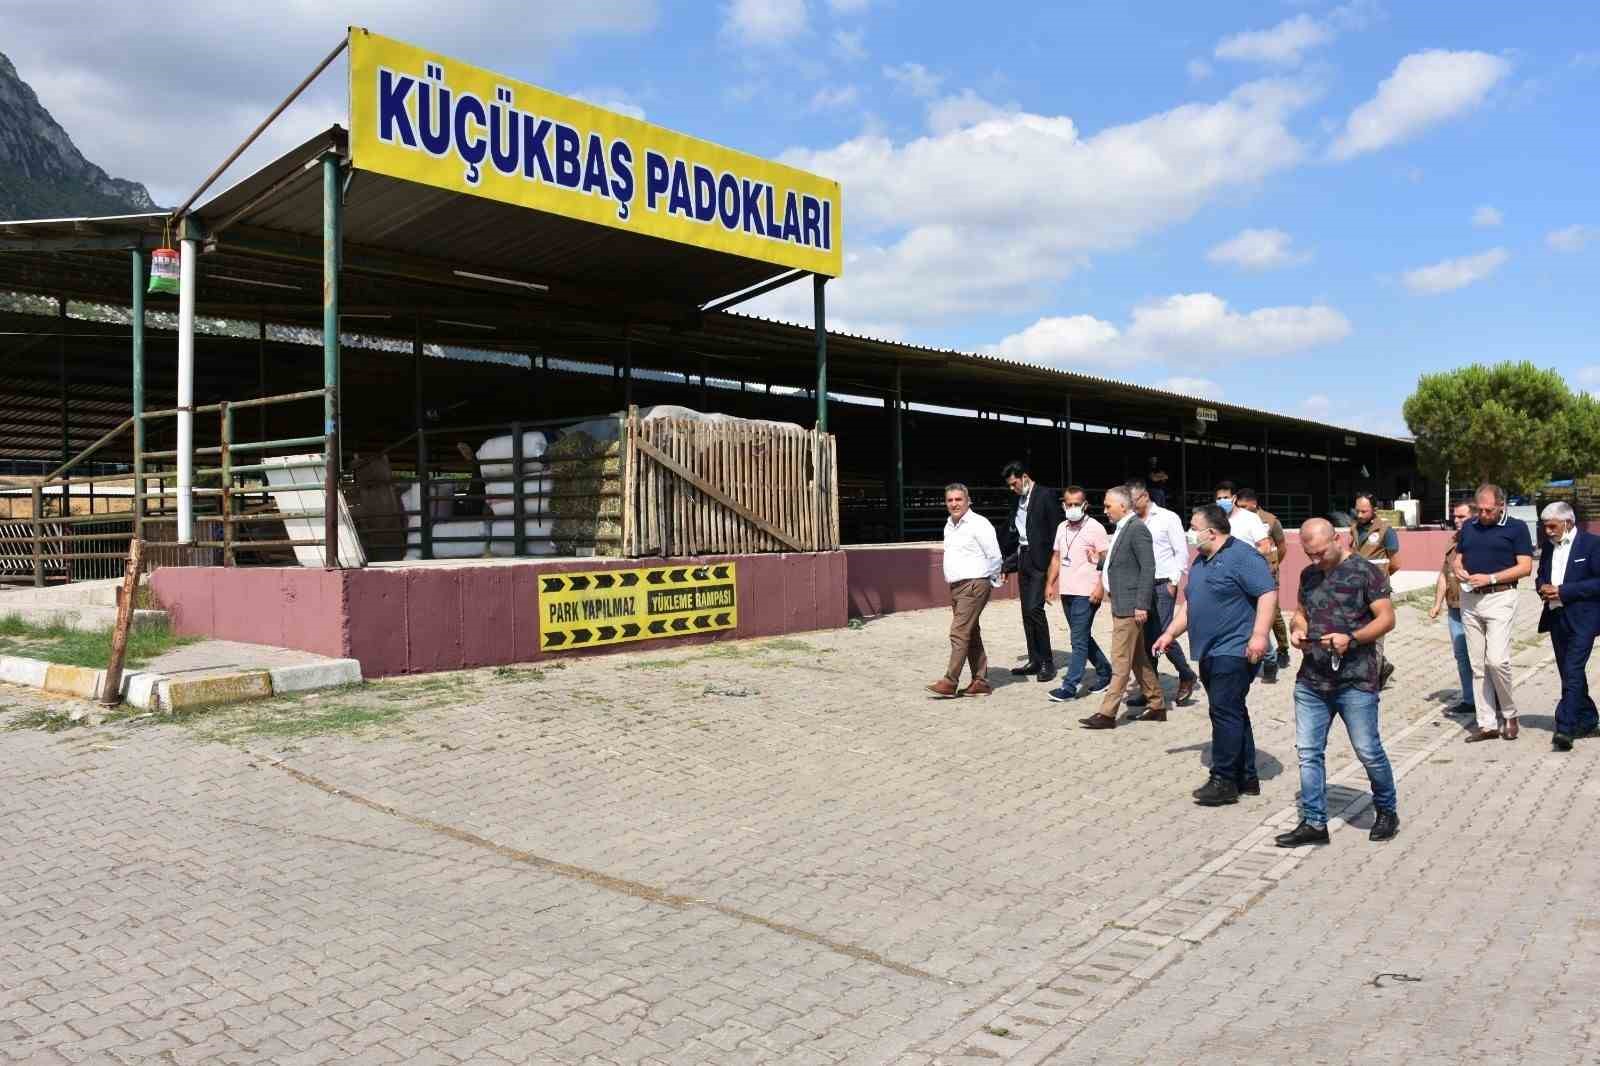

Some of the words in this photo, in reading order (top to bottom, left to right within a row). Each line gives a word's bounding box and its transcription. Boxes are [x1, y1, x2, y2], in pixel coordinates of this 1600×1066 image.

[378, 64, 635, 219] KÜÇÜKBAŞ
[646, 151, 831, 250] PADOKLARI
[549, 602, 580, 623] PARK
[581, 597, 636, 620] YAPILMAZ
[652, 592, 693, 612] YÜKLEME
[694, 590, 732, 606] RAMPASI
